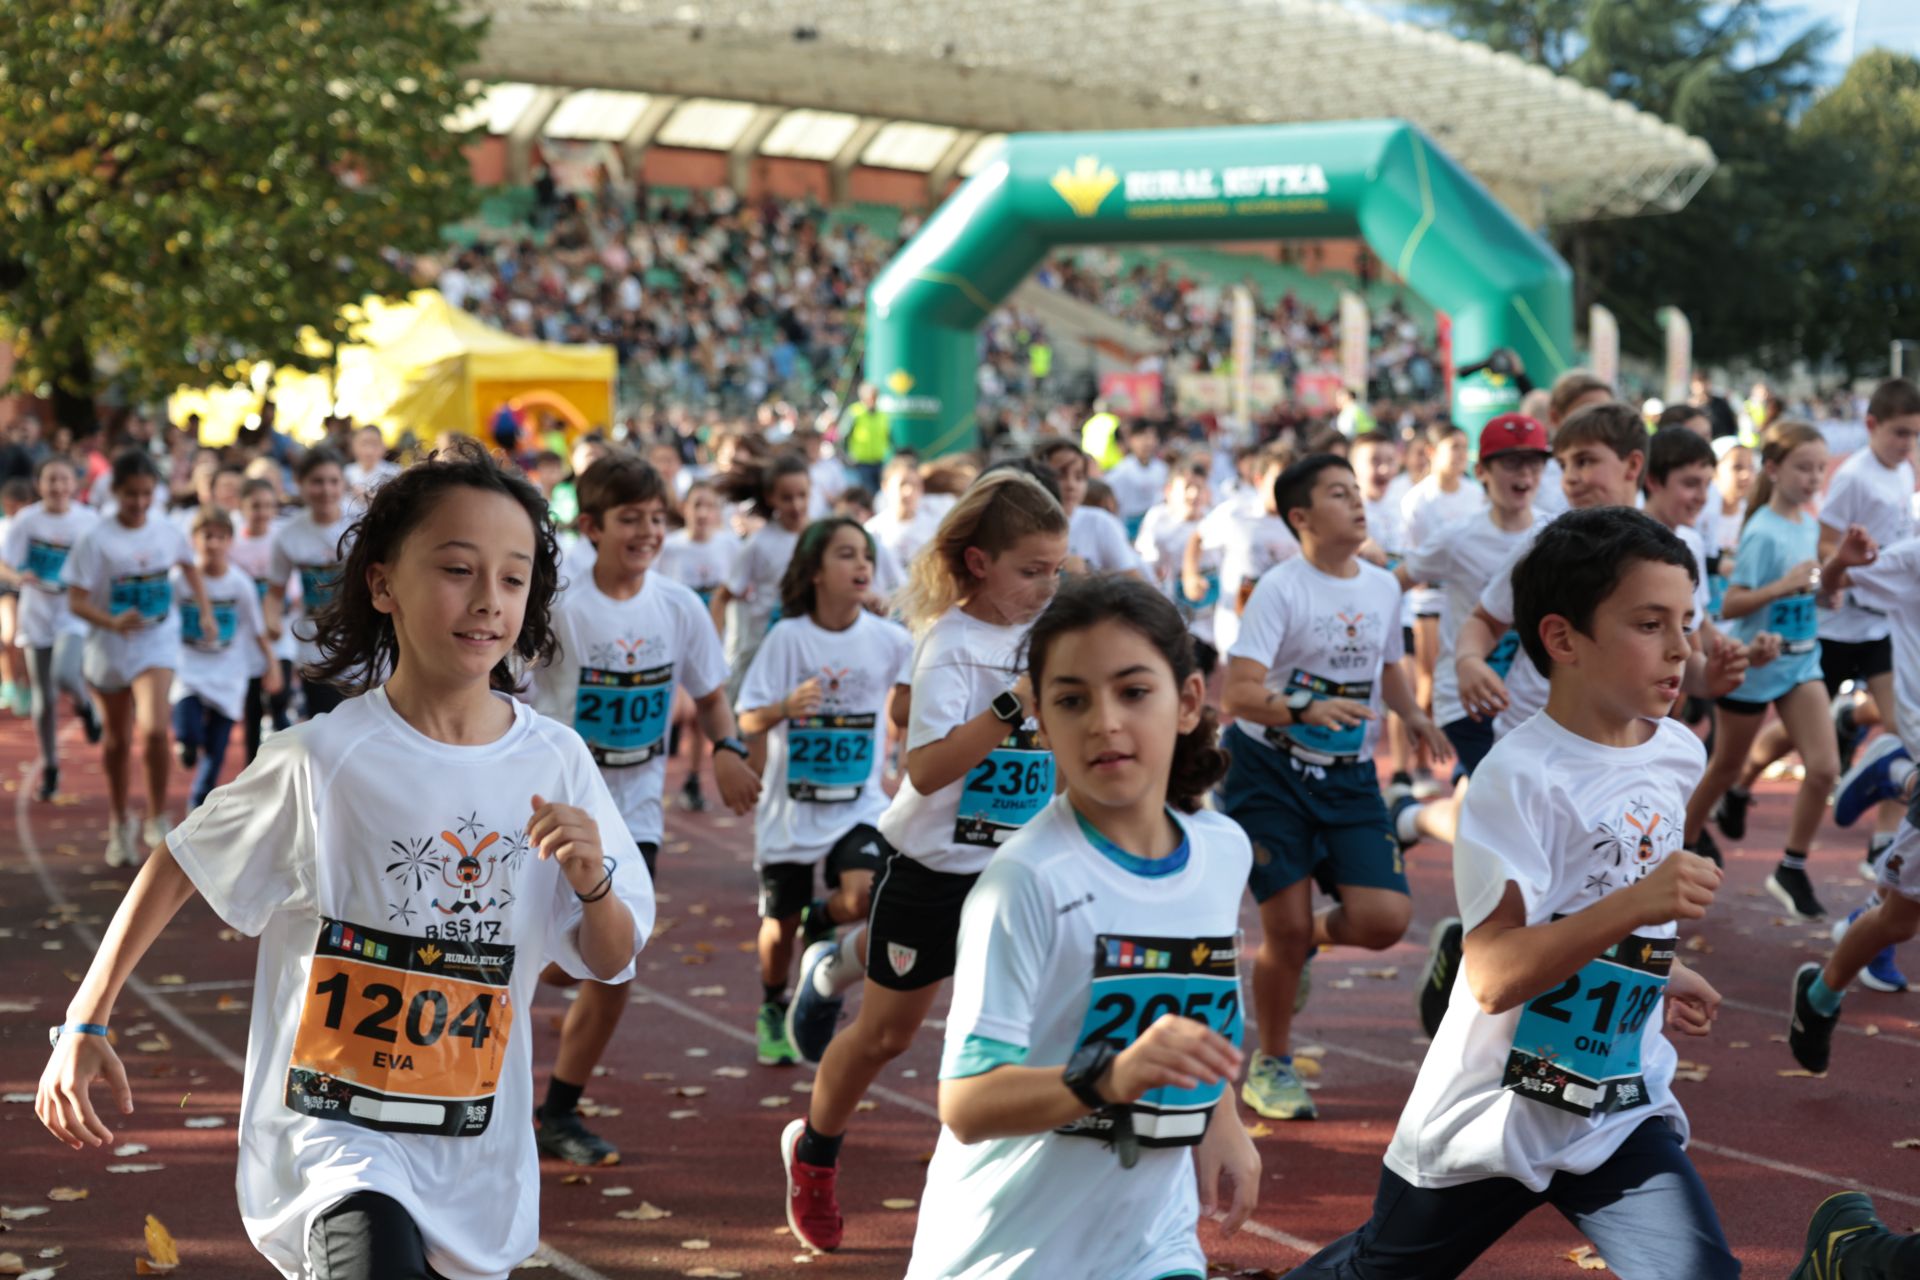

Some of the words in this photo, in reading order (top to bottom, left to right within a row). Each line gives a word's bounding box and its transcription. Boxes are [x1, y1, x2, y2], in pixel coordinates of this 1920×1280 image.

[580, 691, 665, 725] 2103
[791, 736, 867, 763] 2262
[475, 921, 502, 943] 17
[444, 952, 477, 964] RURAL
[315, 972, 495, 1049] 1204
[1528, 973, 1657, 1035] 2128
[373, 1051, 414, 1071] EVA
